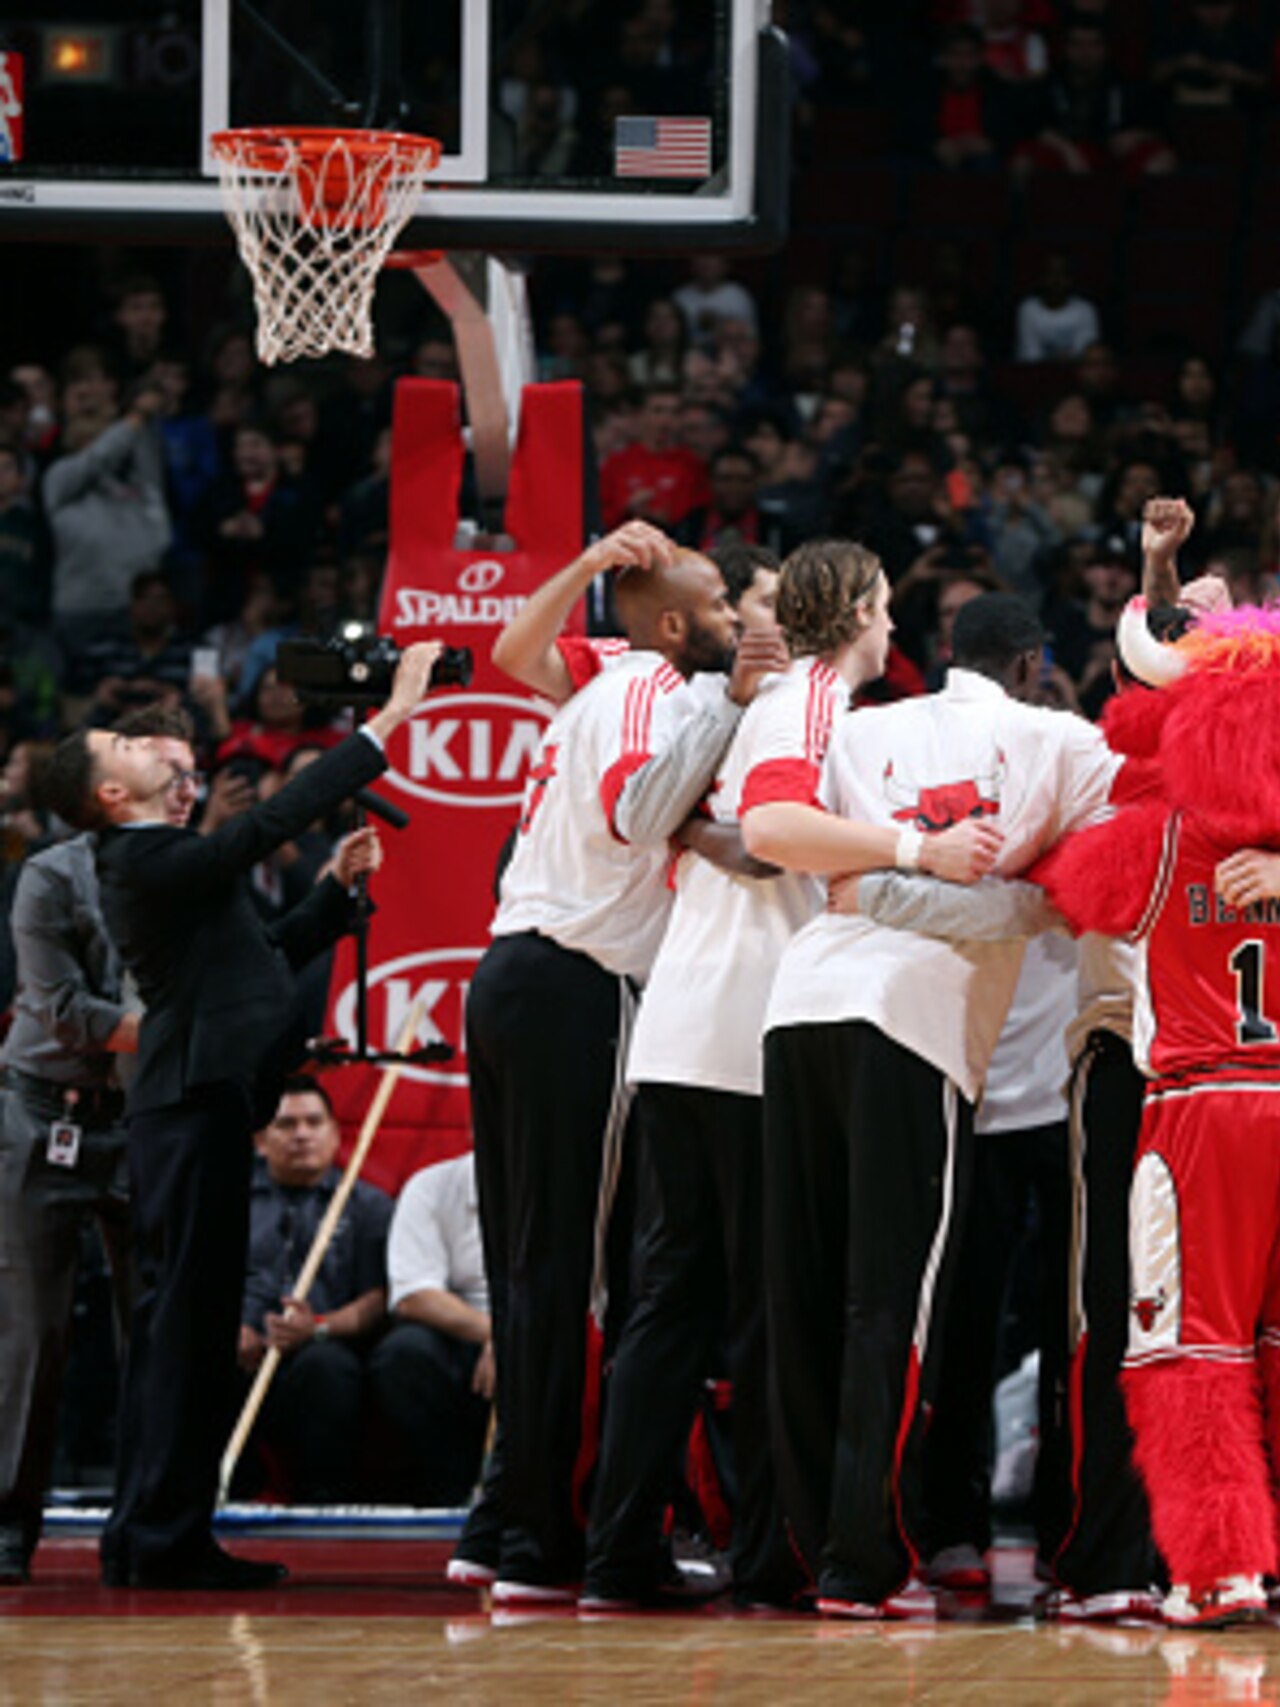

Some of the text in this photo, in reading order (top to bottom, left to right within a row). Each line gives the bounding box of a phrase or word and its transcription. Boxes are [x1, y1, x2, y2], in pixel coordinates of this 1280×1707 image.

[134, 33, 197, 86] 10
[394, 587, 528, 628] SPALDI
[409, 719, 542, 780] KIA
[1227, 938, 1280, 1047] 1
